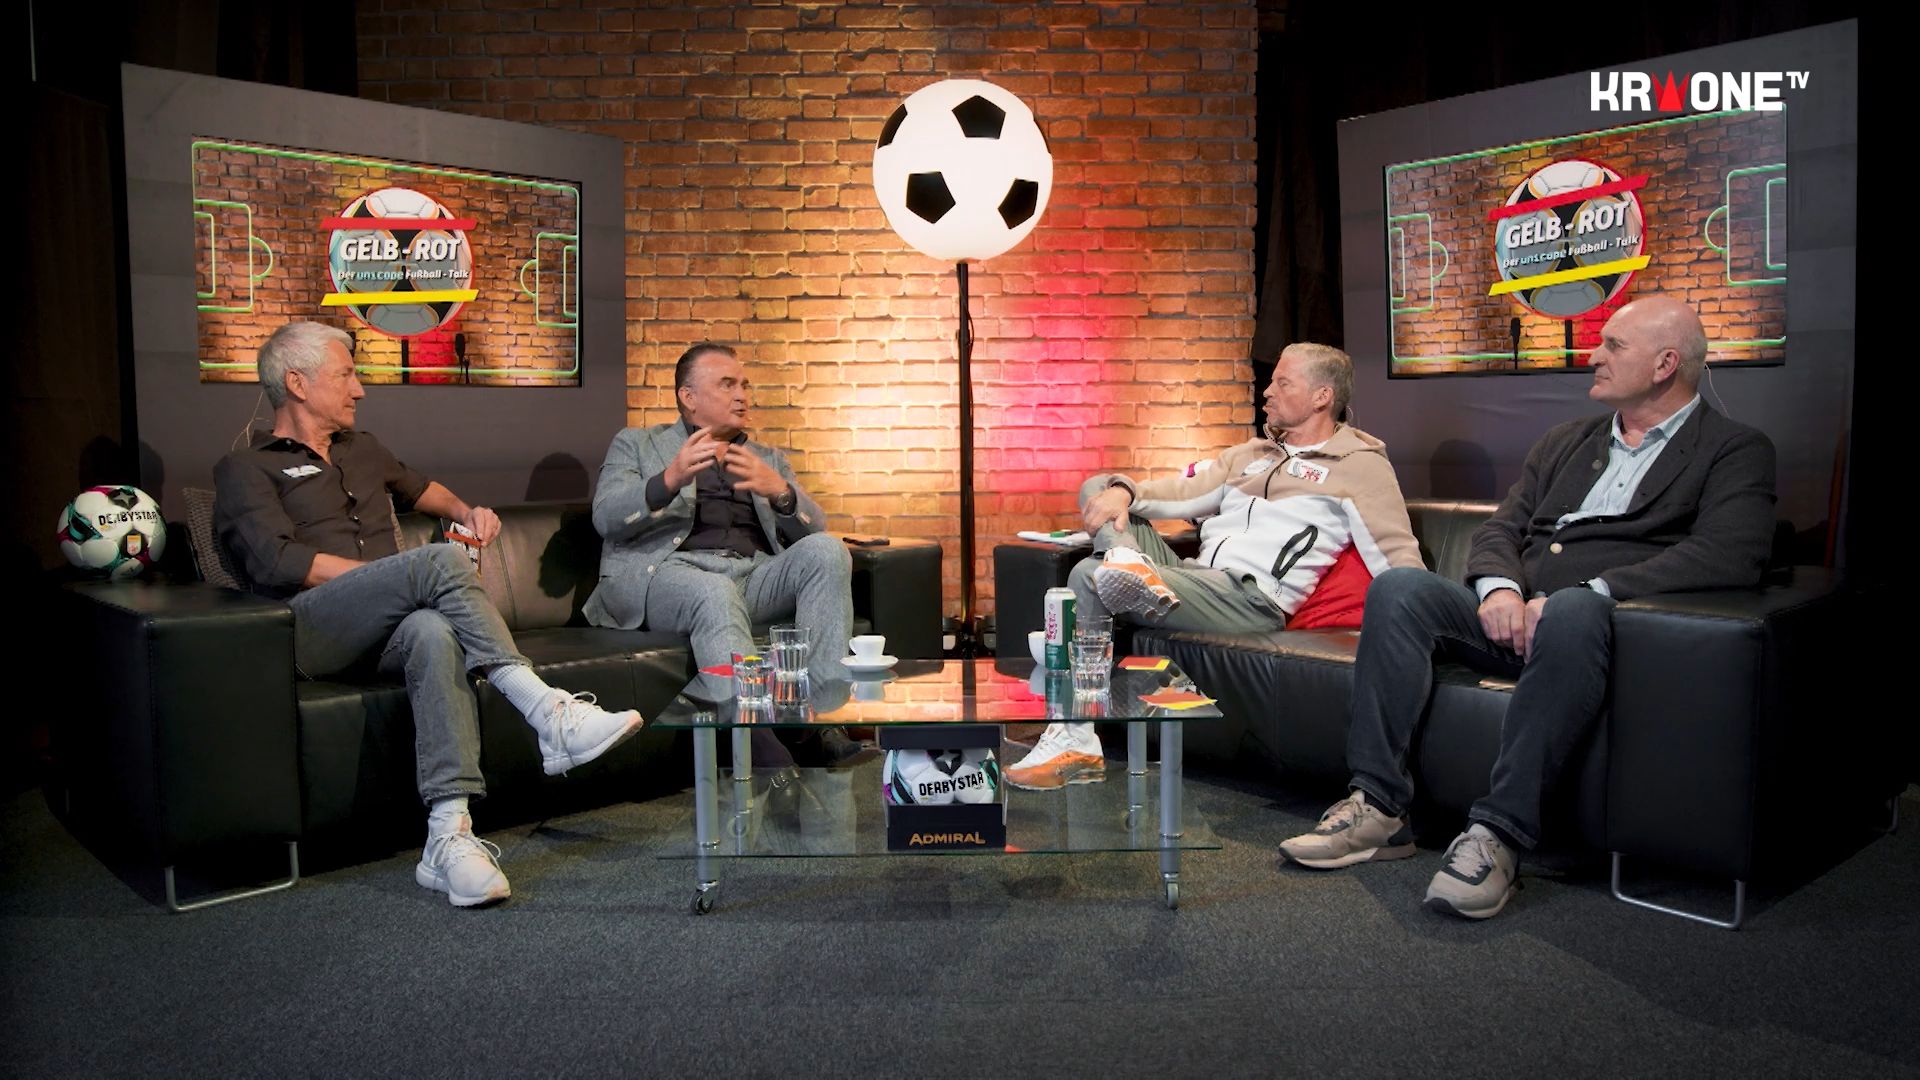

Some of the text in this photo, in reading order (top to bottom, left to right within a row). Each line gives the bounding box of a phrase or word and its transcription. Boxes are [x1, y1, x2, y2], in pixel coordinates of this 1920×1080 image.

[1504, 217, 1562, 249] GELB
[1578, 201, 1630, 235] ROT
[340, 238, 399, 261] GELB
[415, 238, 462, 261] ROT
[1615, 235, 1640, 248] Talk
[448, 269, 469, 279] Talk
[919, 772, 985, 797] DERBYSTAR
[908, 832, 986, 847] ADMIRAL
